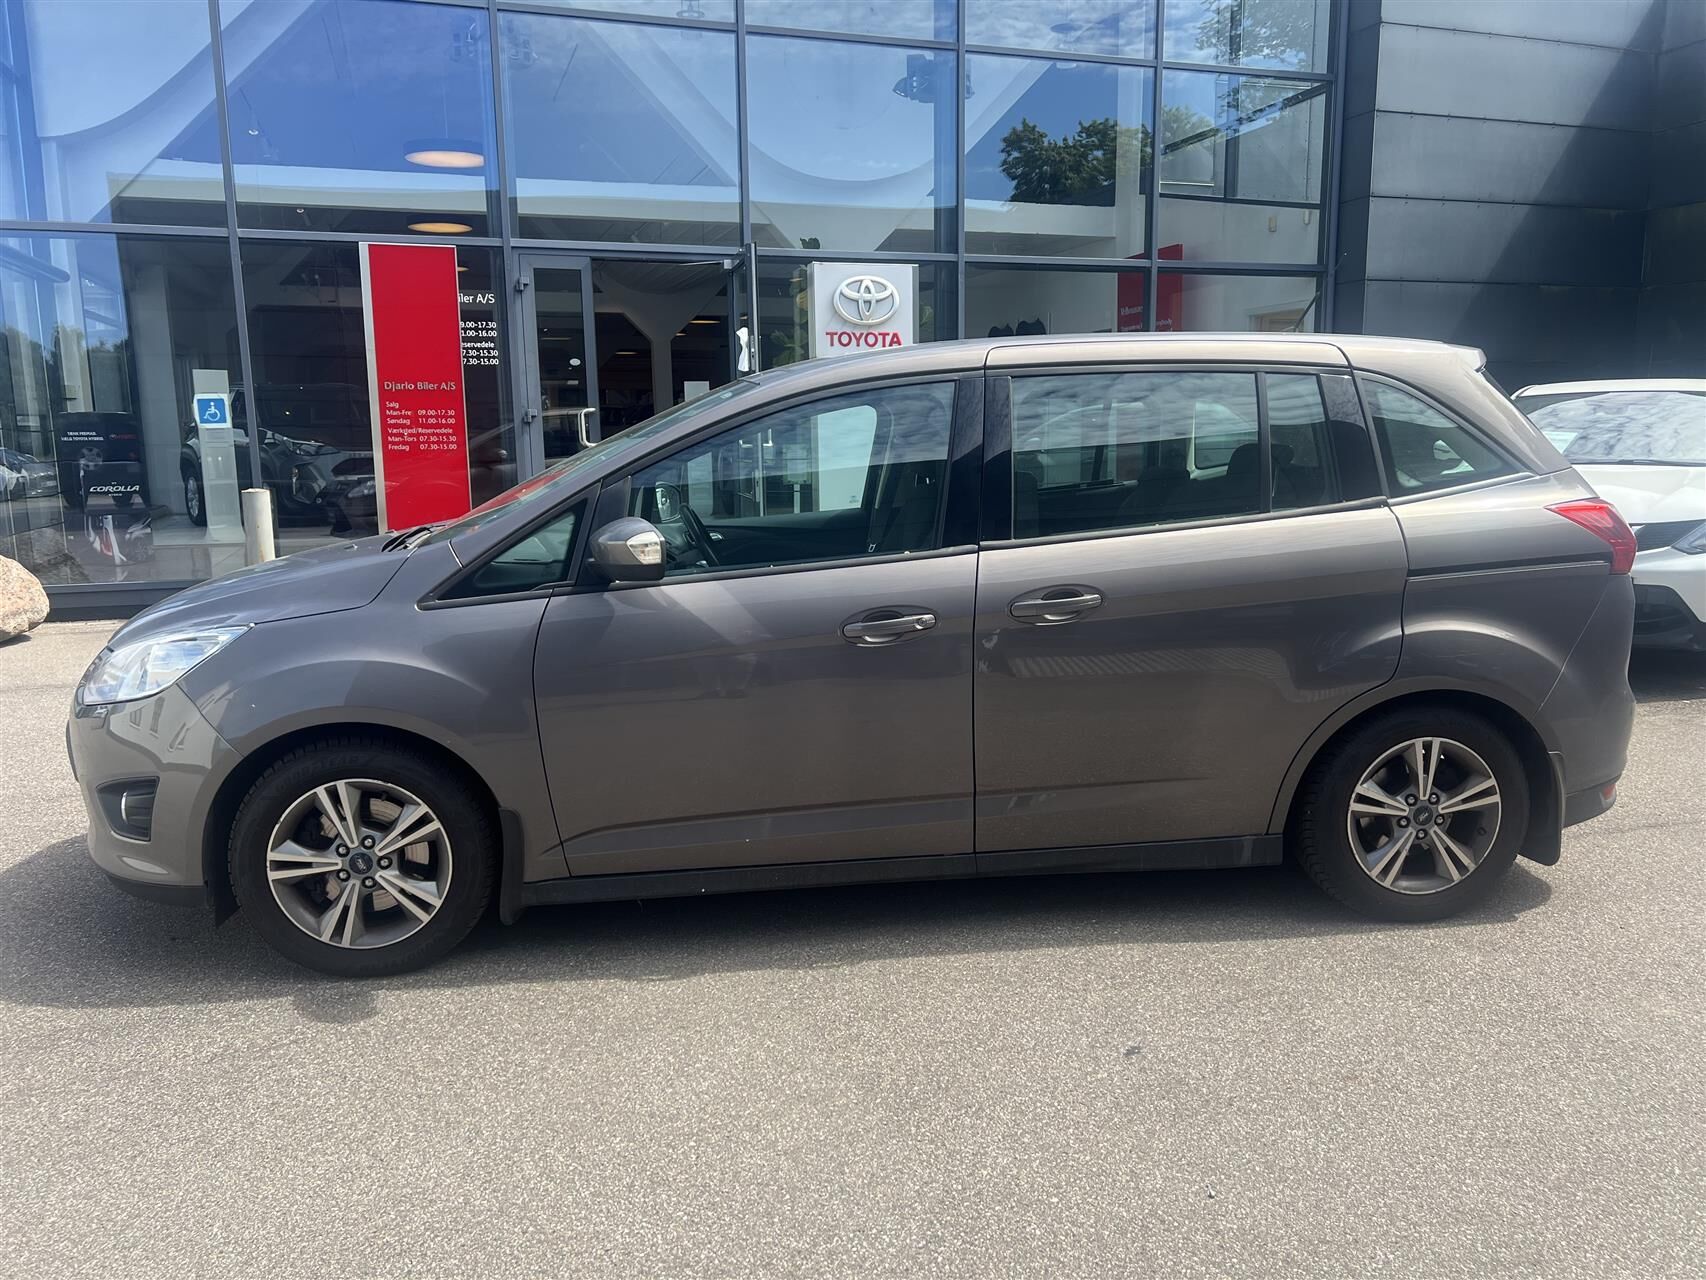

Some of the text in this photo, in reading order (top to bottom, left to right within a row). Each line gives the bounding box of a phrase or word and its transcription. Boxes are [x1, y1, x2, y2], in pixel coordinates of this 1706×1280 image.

[476, 293, 495, 304] A/S
[825, 331, 902, 348] TOYOTA
[384, 381, 456, 392] Djarlo Biler A/S
[385, 401, 400, 409] Salg
[388, 443, 410, 451] Fredag
[89, 485, 140, 493] COROLLA
